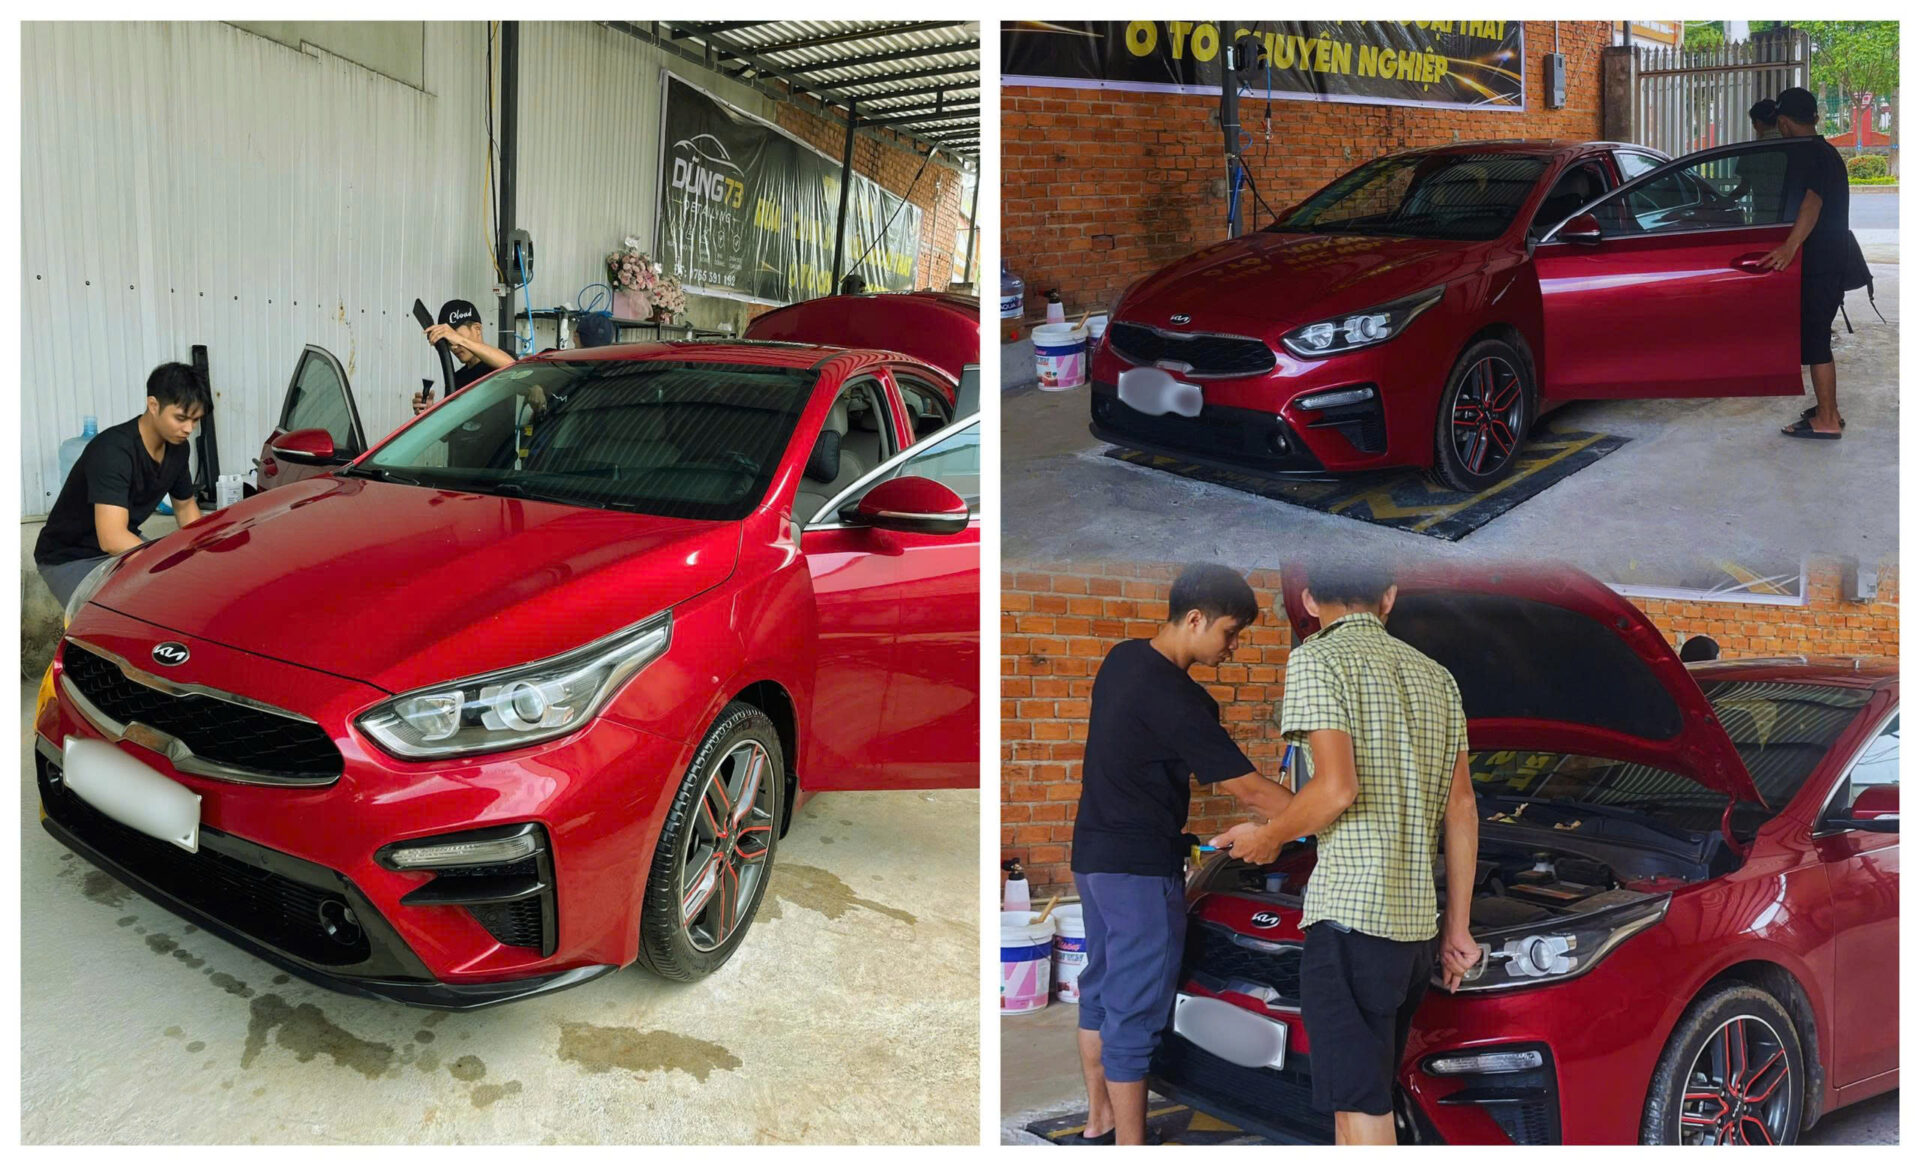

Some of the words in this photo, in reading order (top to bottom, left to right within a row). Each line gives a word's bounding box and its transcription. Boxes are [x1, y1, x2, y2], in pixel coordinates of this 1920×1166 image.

[1357, 44, 1448, 92] NGHIỆP
[689, 267, 707, 282] 765
[449, 307, 472, 324] Cloud
